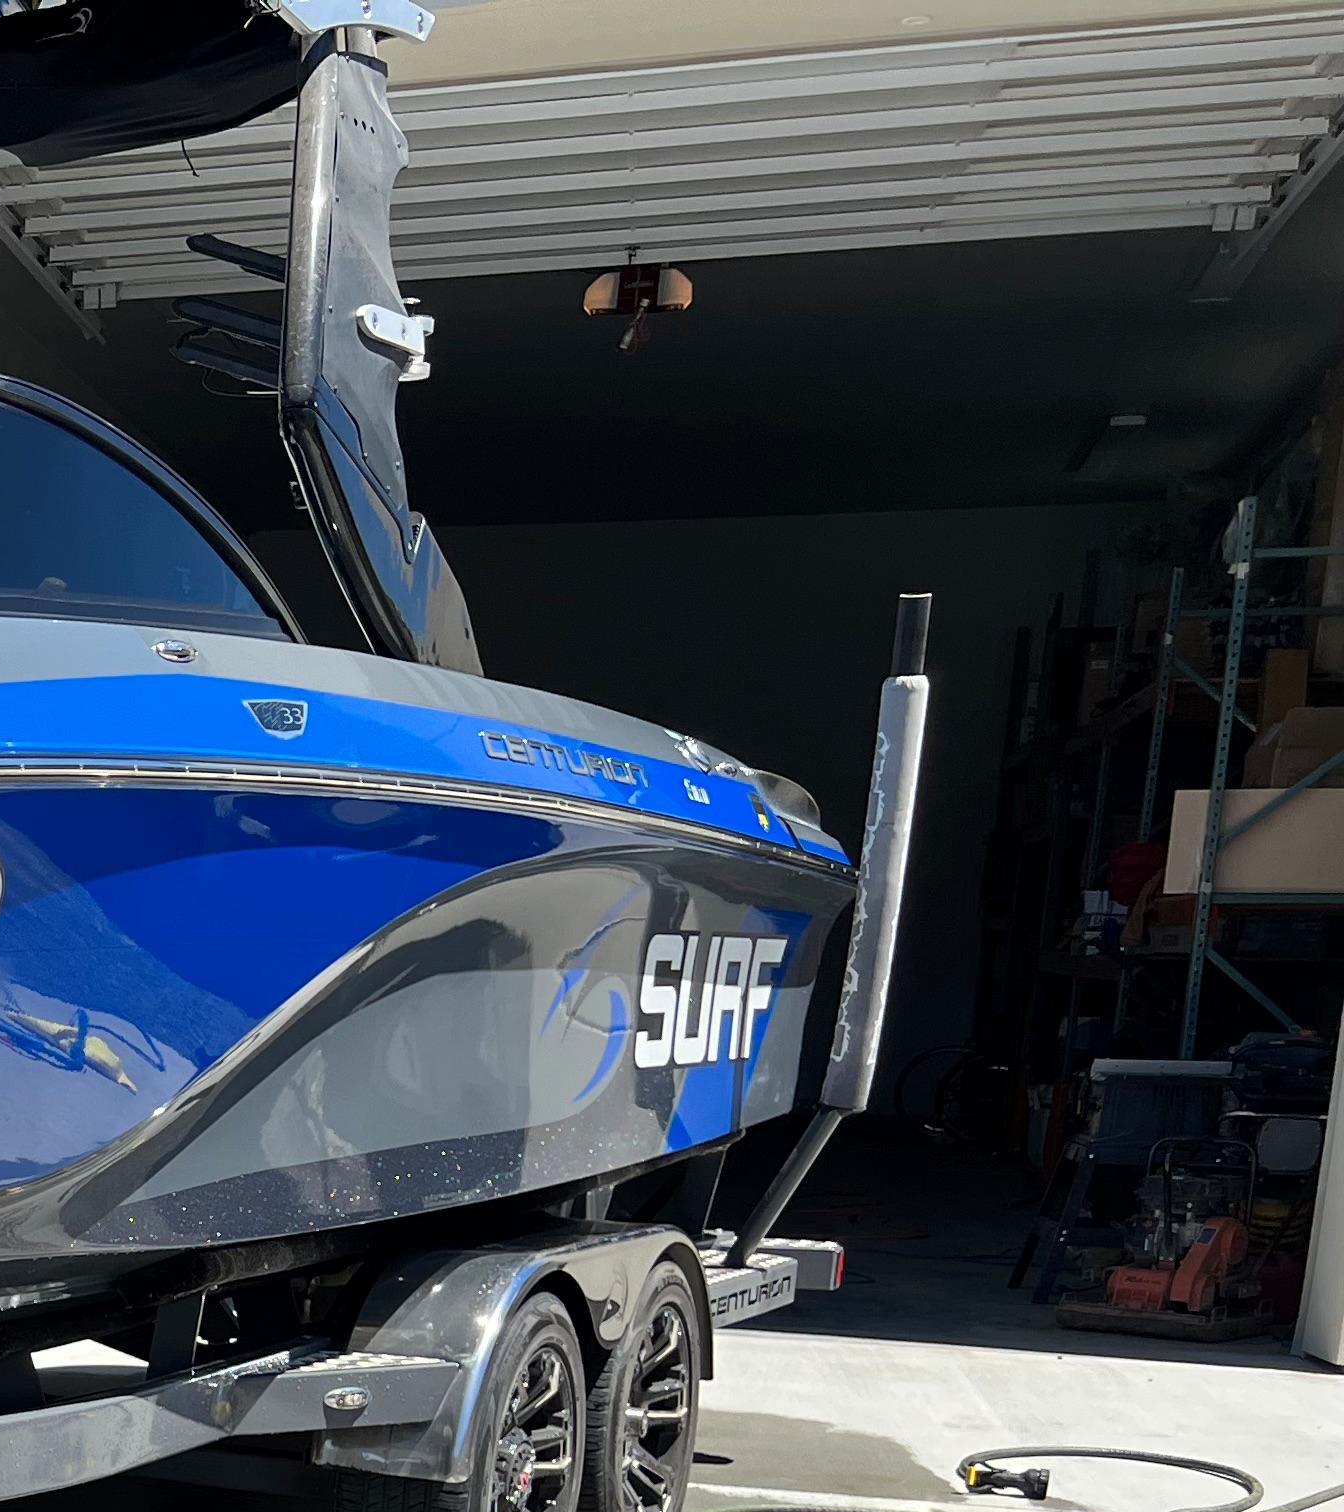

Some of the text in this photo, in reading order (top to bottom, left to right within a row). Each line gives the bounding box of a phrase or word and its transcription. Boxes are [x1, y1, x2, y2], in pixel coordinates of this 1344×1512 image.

[280, 707, 304, 725] 33
[478, 731, 649, 788] CENTURION
[635, 933, 788, 1069] SURF
